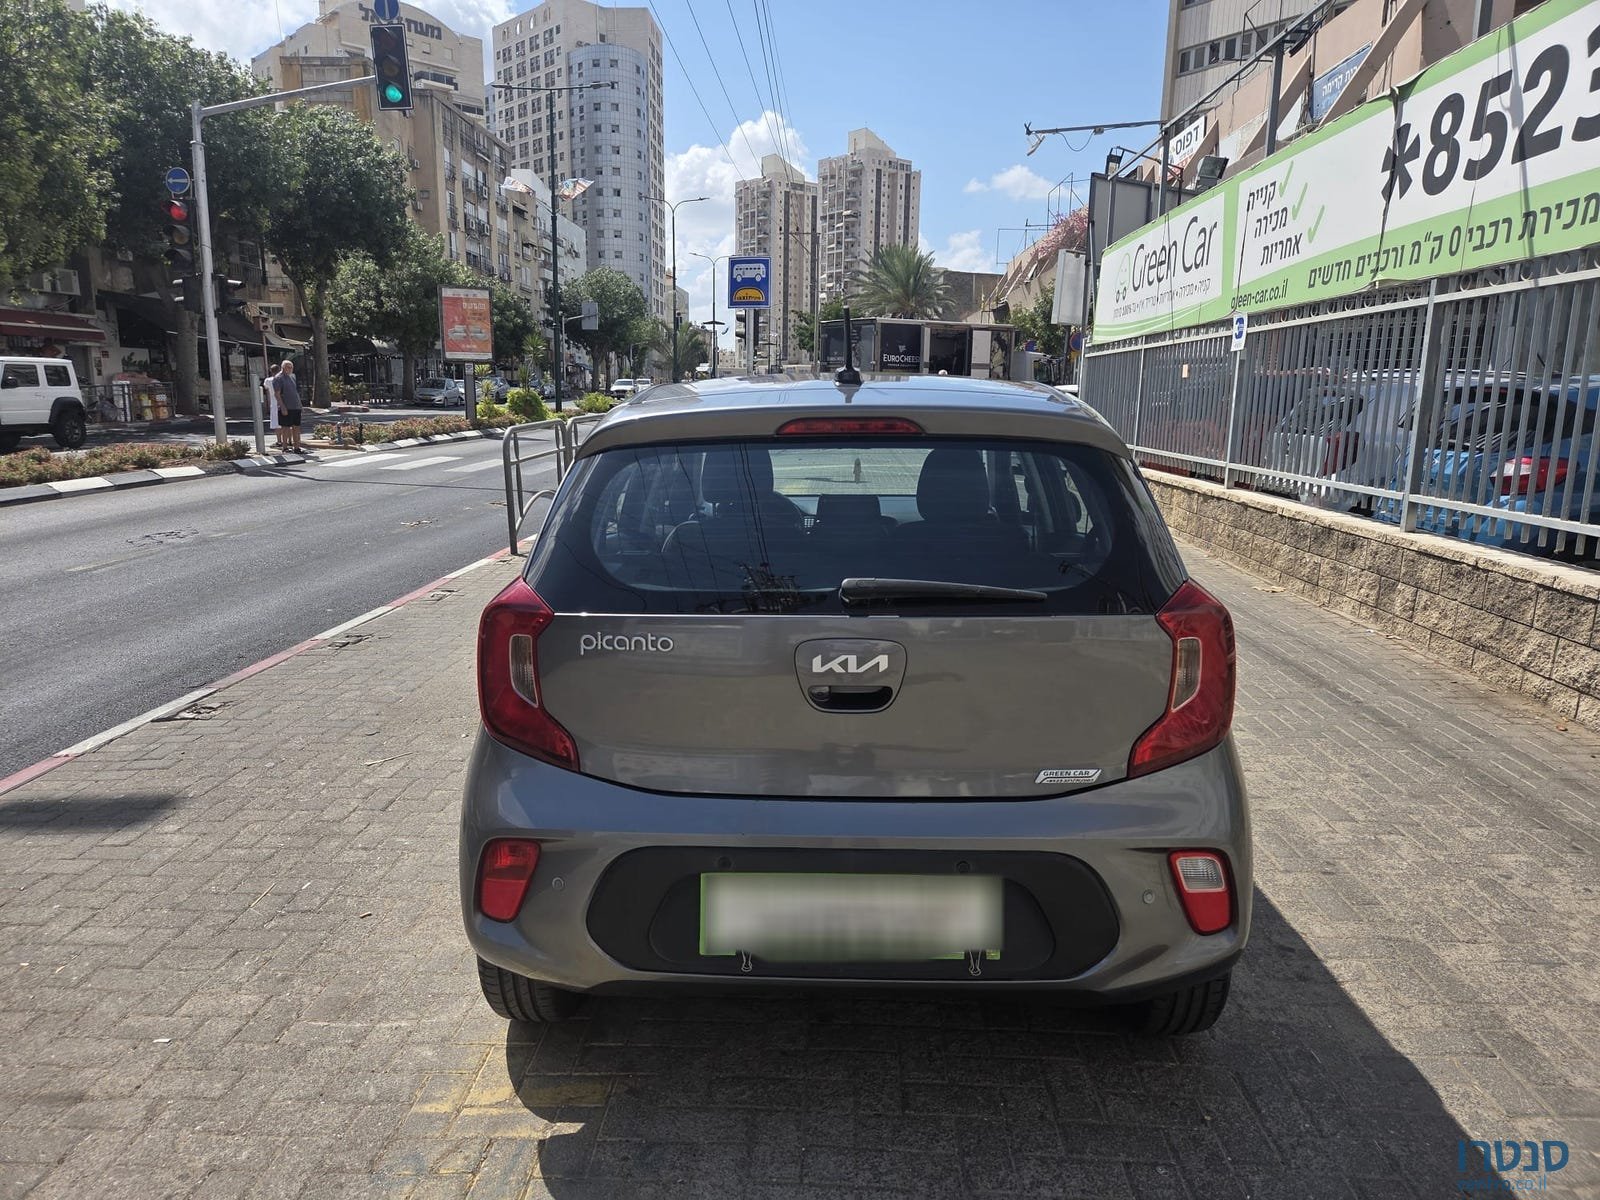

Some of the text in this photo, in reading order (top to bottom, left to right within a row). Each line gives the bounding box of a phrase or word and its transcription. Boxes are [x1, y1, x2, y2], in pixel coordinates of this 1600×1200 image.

[1176, 125, 1199, 155] דפוס
[1254, 206, 1288, 239] מכירה
[1517, 192, 1600, 241] מכירת
[1260, 232, 1303, 266] אחריות
[1448, 225, 1462, 257] 0
[1467, 216, 1513, 253] רכבי
[1132, 215, 1218, 292] Green Car
[1307, 259, 1352, 289] חדשים
[579, 631, 675, 656] picanto
[811, 654, 889, 674] KIA
